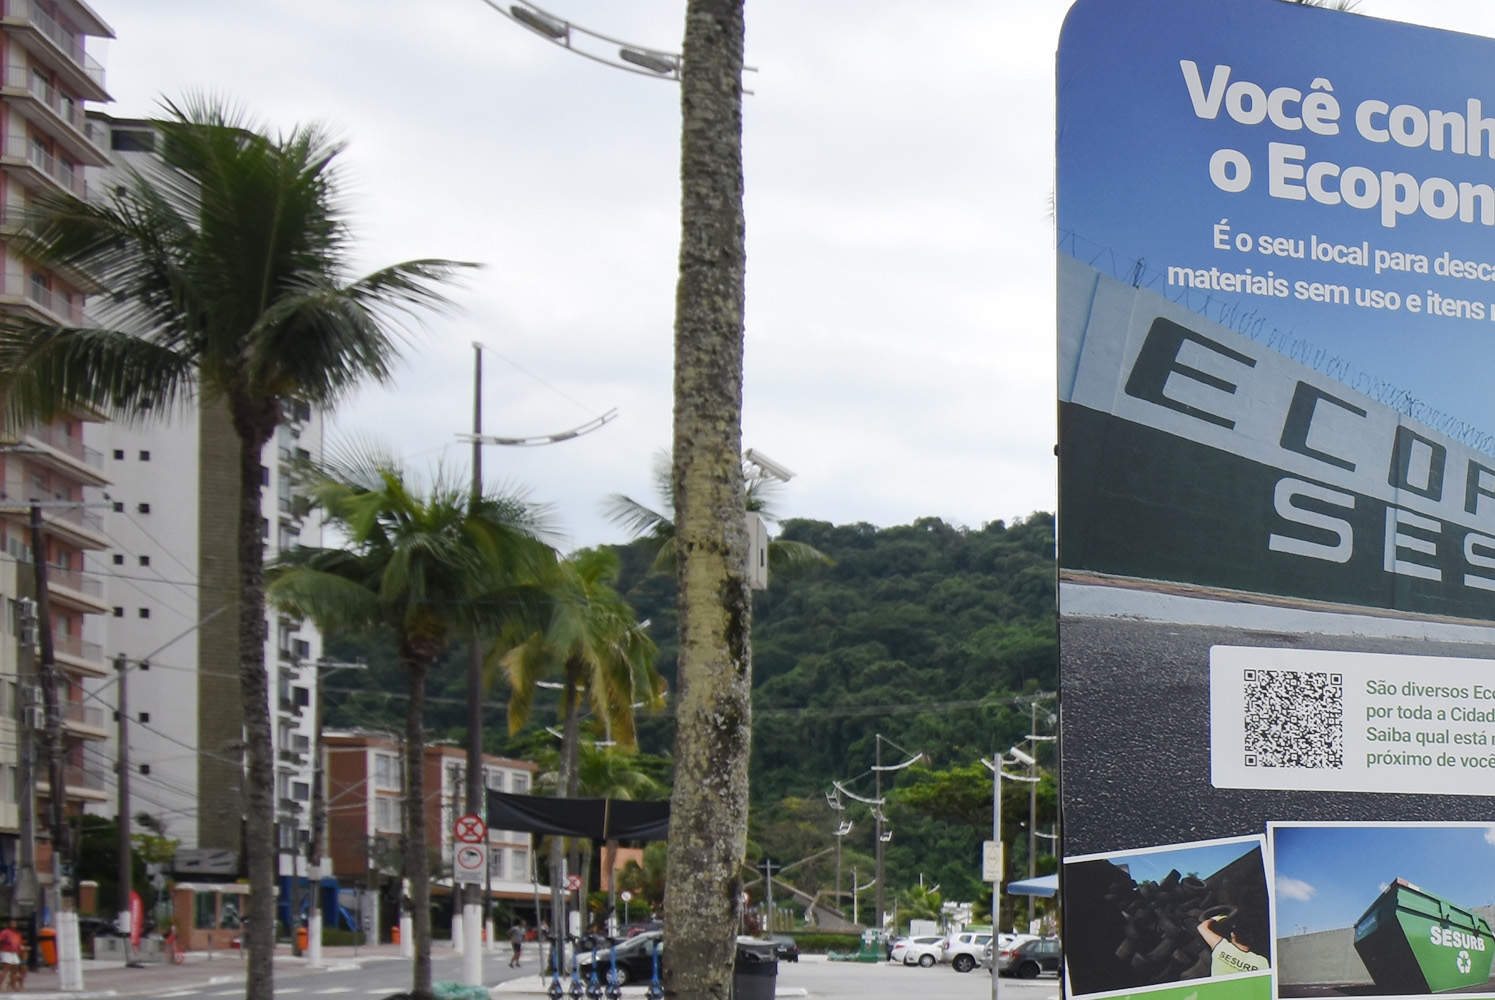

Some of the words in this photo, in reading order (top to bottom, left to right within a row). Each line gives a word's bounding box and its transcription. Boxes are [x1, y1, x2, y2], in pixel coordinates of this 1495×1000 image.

[1179, 59, 1340, 136] Você
[1209, 147, 1252, 193] o
[1213, 218, 1231, 250] É
[1236, 230, 1252, 252] o
[1258, 234, 1305, 260] seu
[1310, 234, 1369, 267] local
[1374, 248, 1429, 275] para
[1167, 264, 1289, 297] materiais
[1294, 278, 1349, 305] sem
[1355, 287, 1401, 312] uso
[1406, 294, 1422, 314] e
[1427, 290, 1486, 320] itens
[1366, 679, 1397, 697] São
[1401, 682, 1469, 700] diversos
[1366, 705, 1393, 722] por
[1398, 704, 1434, 722] toda
[1437, 709, 1447, 722] a
[1366, 726, 1412, 744] Saiba
[1416, 728, 1450, 747] qual
[1453, 730, 1487, 746] está
[1366, 750, 1433, 768] próximo
[1436, 752, 1456, 768] de
[1430, 925, 1485, 951] SESURB
